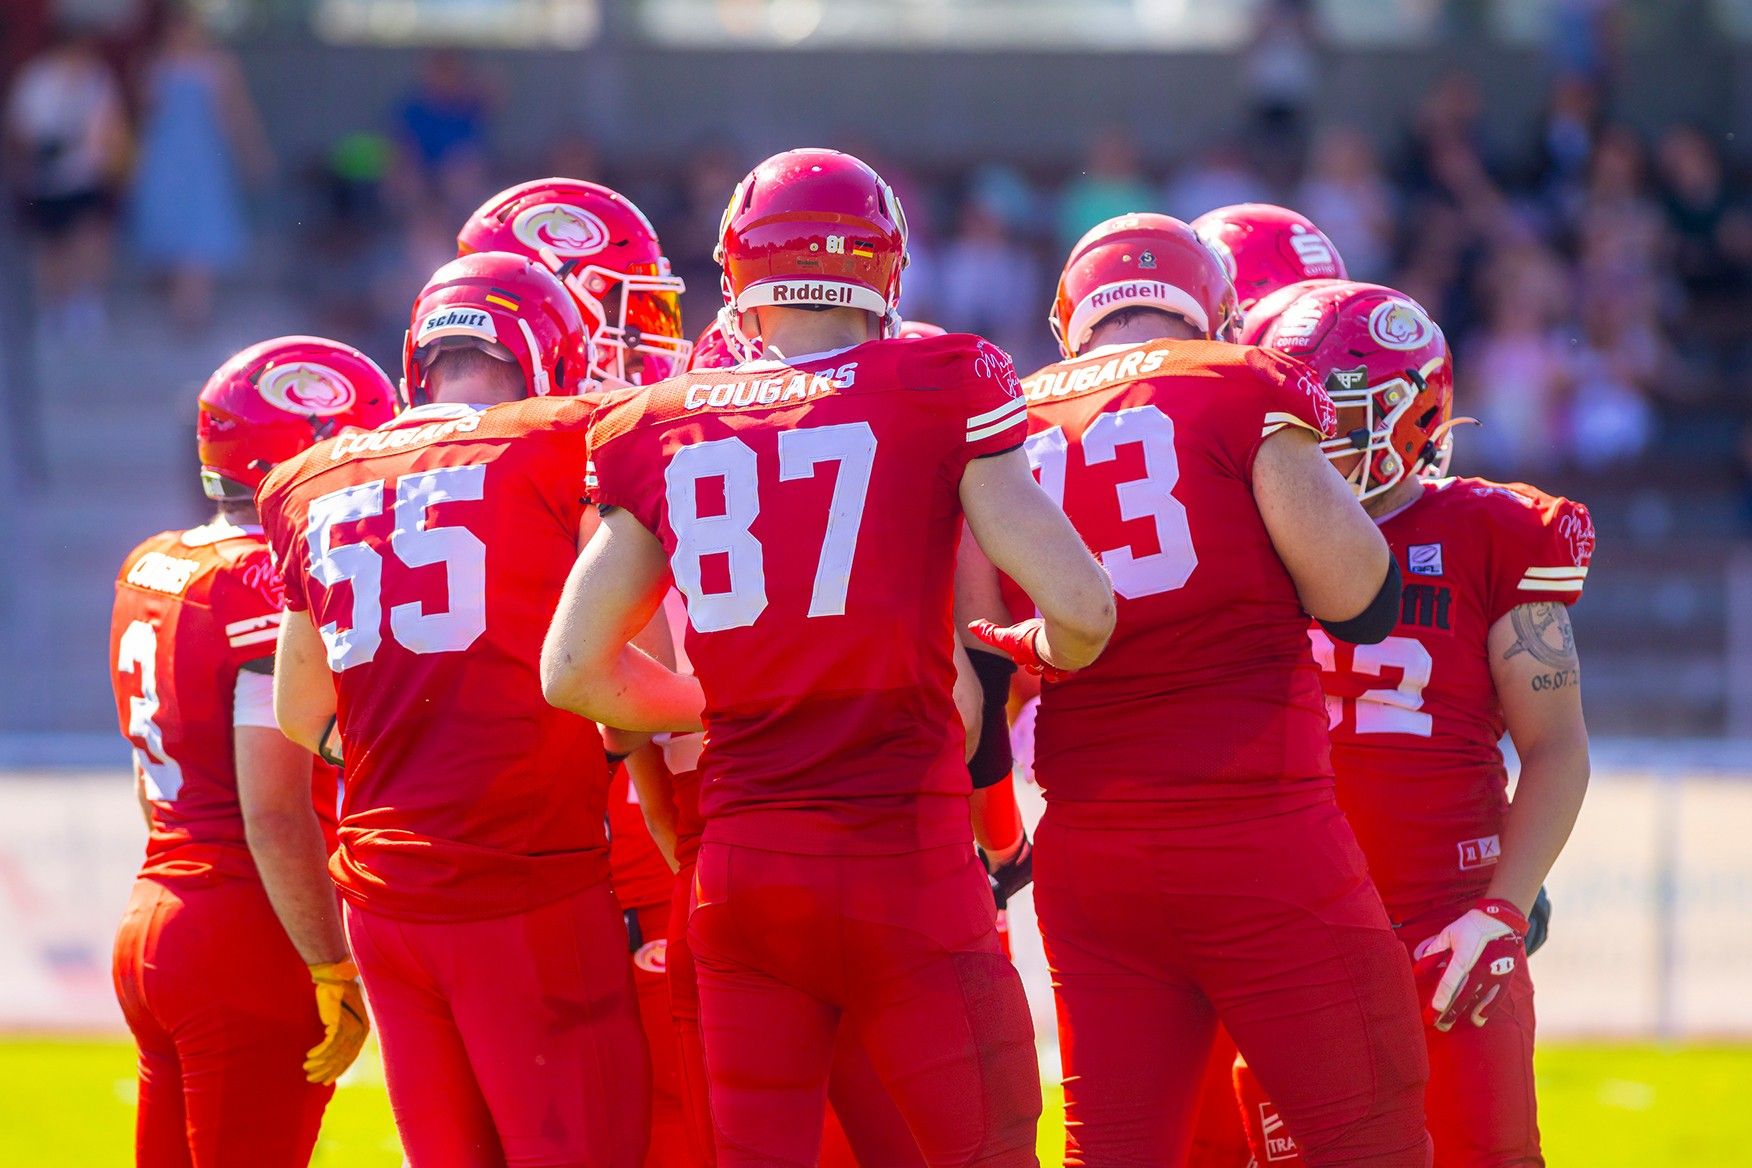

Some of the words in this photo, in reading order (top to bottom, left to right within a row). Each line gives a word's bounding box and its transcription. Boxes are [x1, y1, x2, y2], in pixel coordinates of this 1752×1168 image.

[826, 235, 845, 254] 81
[773, 284, 853, 303] Riddell
[1091, 284, 1166, 307] Riddell
[1277, 337, 1309, 348] corner
[684, 363, 859, 410] COUGARS
[664, 421, 878, 633] 87
[305, 463, 487, 674] 55
[118, 620, 184, 801] 3
